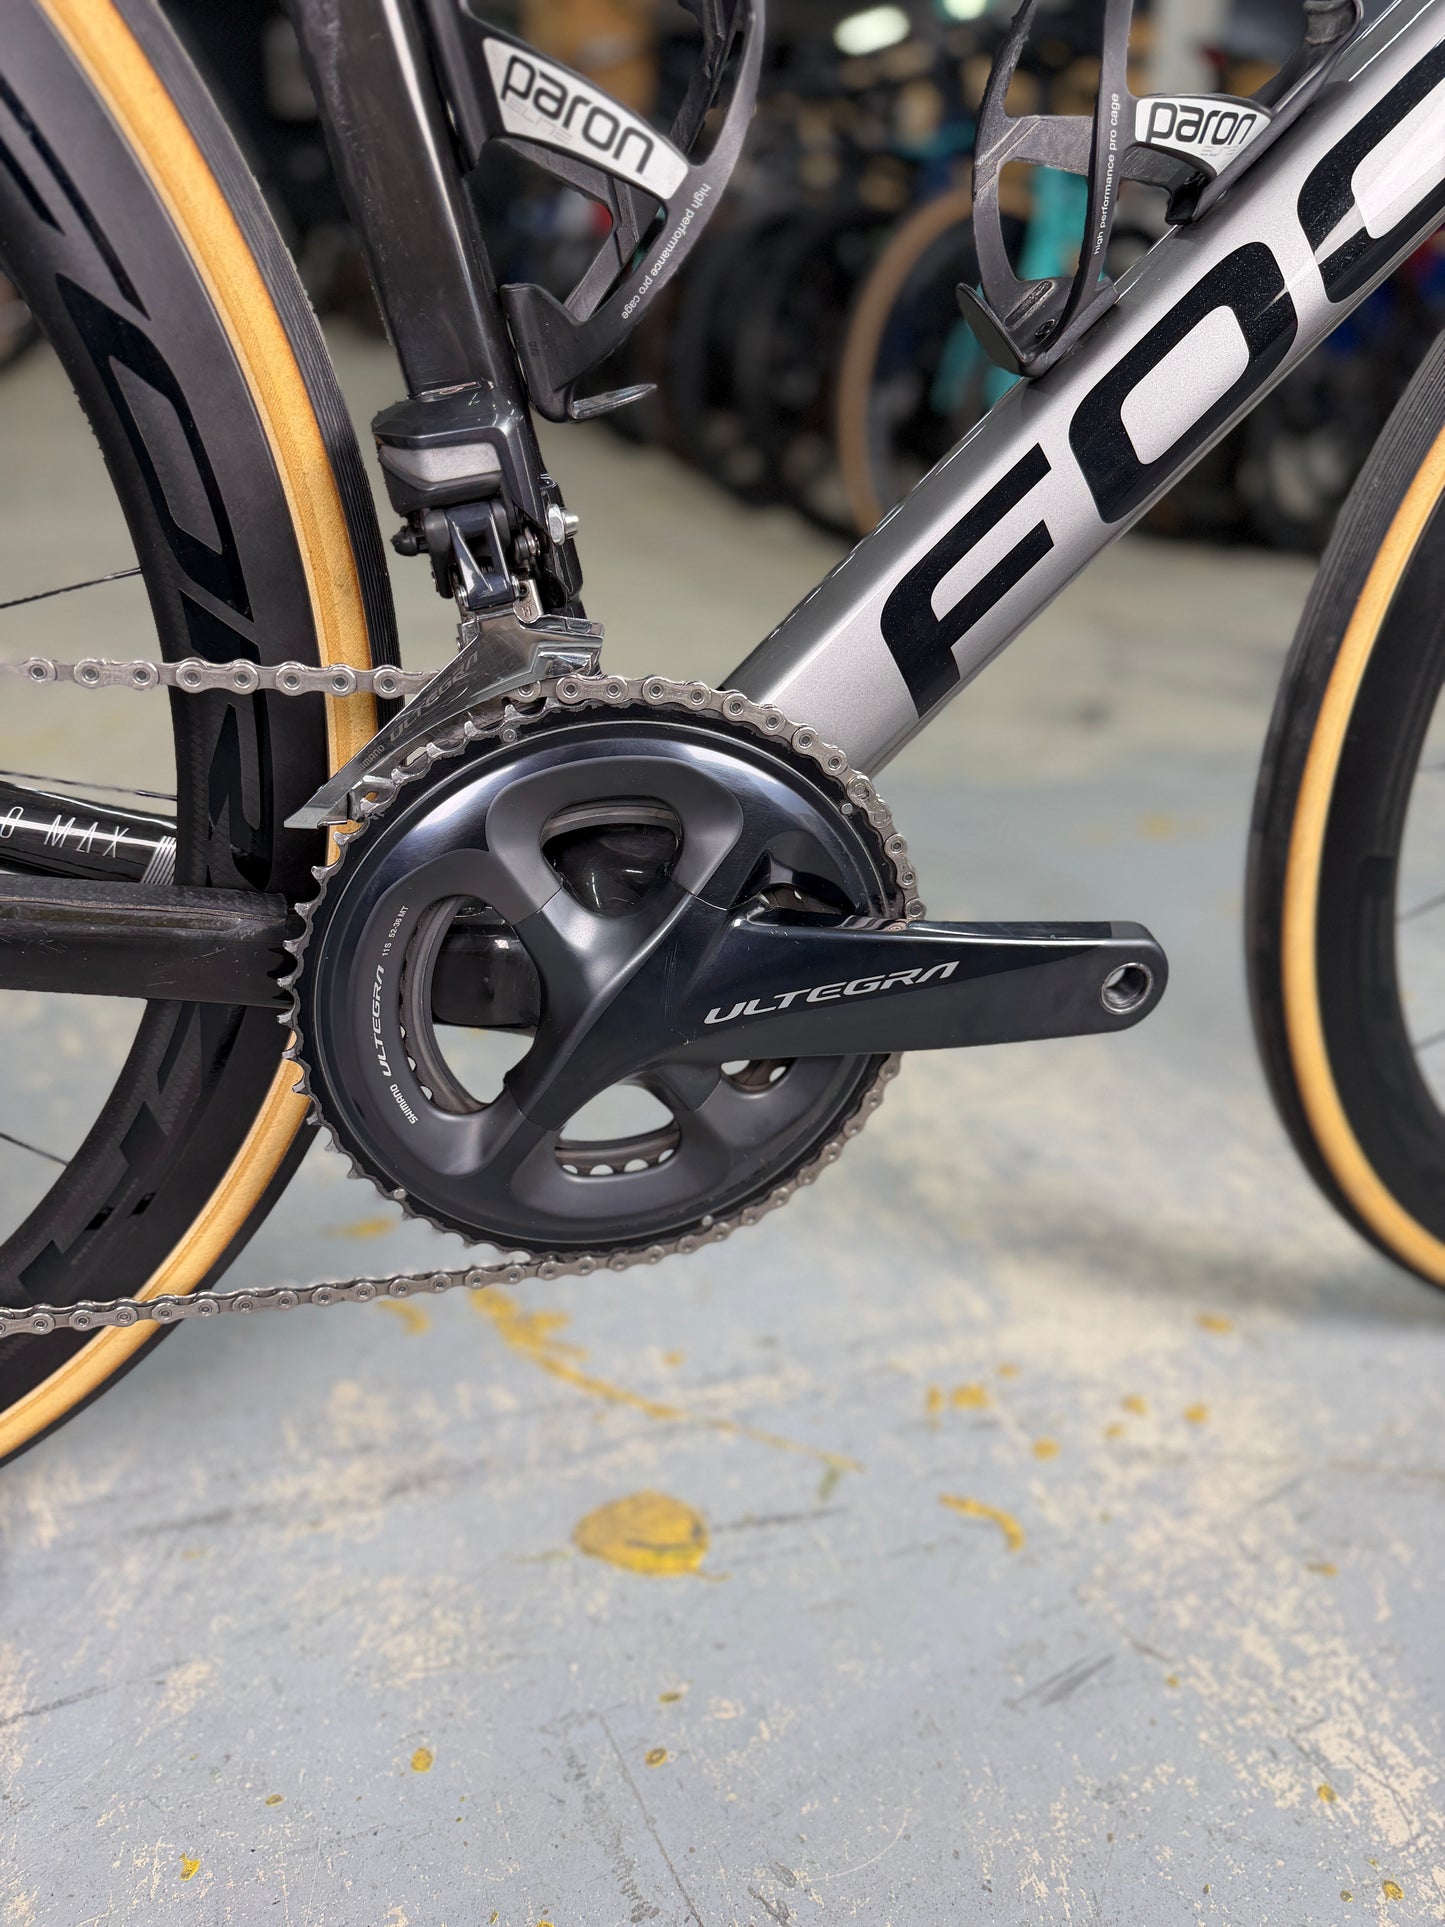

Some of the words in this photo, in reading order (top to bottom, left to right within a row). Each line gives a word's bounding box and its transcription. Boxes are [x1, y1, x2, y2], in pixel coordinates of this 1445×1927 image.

[501, 54, 655, 175] paron
[1111, 92, 1120, 126] cage
[1145, 101, 1258, 146] paron
[1108, 130, 1117, 151] pro
[691, 183, 712, 209] high
[1099, 154, 1115, 229] performance
[650, 207, 695, 277] performance
[1093, 231, 1104, 255] high
[638, 275, 653, 295] pro
[621, 295, 641, 320] cage
[389, 650, 479, 742] ULTEGRA
[43, 814, 130, 859] MAX
[388, 918, 402, 938] 52-36
[399, 905, 409, 919] MT
[381, 942, 392, 957] 11S
[703, 960, 961, 1025] ULTEGRA
[372, 964, 392, 1078] ULTEGRA
[389, 1083, 419, 1125] SHIMANO
